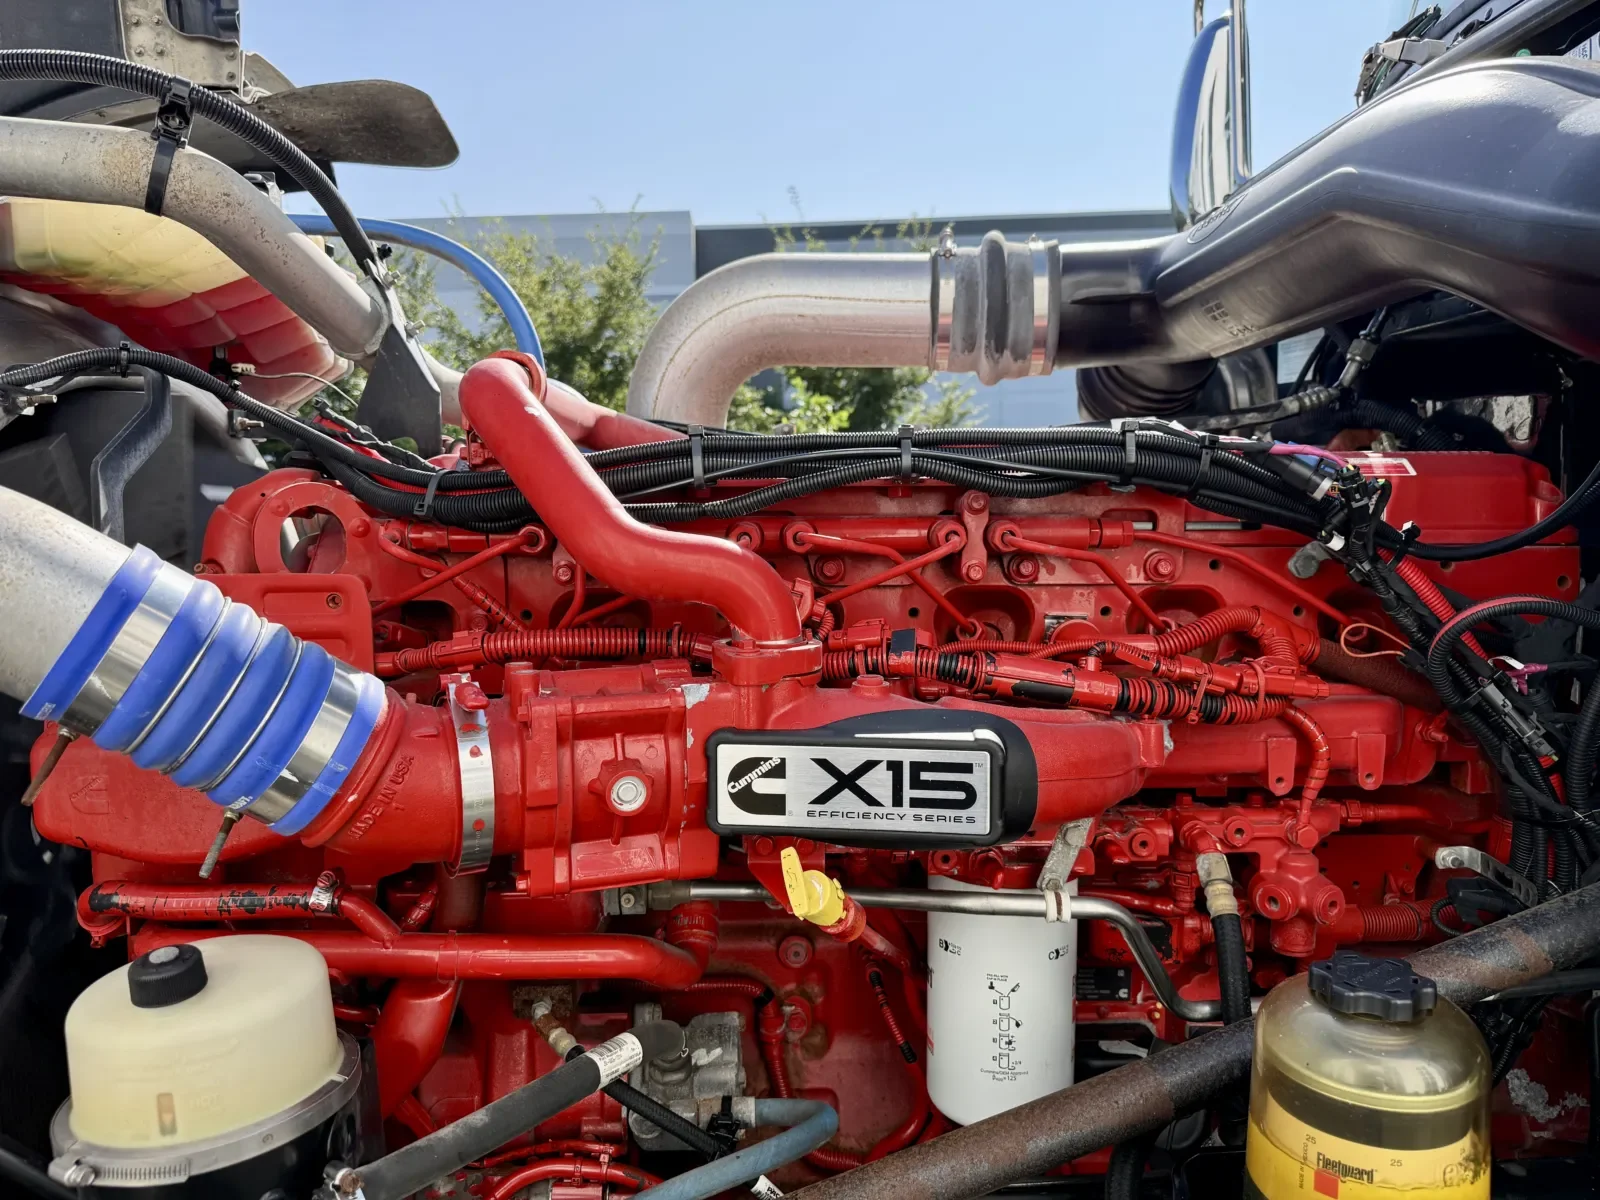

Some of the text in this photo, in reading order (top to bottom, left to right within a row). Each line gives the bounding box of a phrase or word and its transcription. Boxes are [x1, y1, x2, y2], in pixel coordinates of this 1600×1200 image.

[727, 756, 978, 811] Cummins X15
[348, 804, 385, 841] MADE
[377, 785, 397, 806] IN
[389, 755, 415, 786] USA
[806, 810, 977, 825] EFFICIENCY SERIES
[938, 938, 944, 949] B
[1048, 951, 1055, 961] C
[1305, 1134, 1317, 1145] 25
[1316, 1151, 1374, 1184] Fleetguard
[1390, 1158, 1403, 1167] 25
